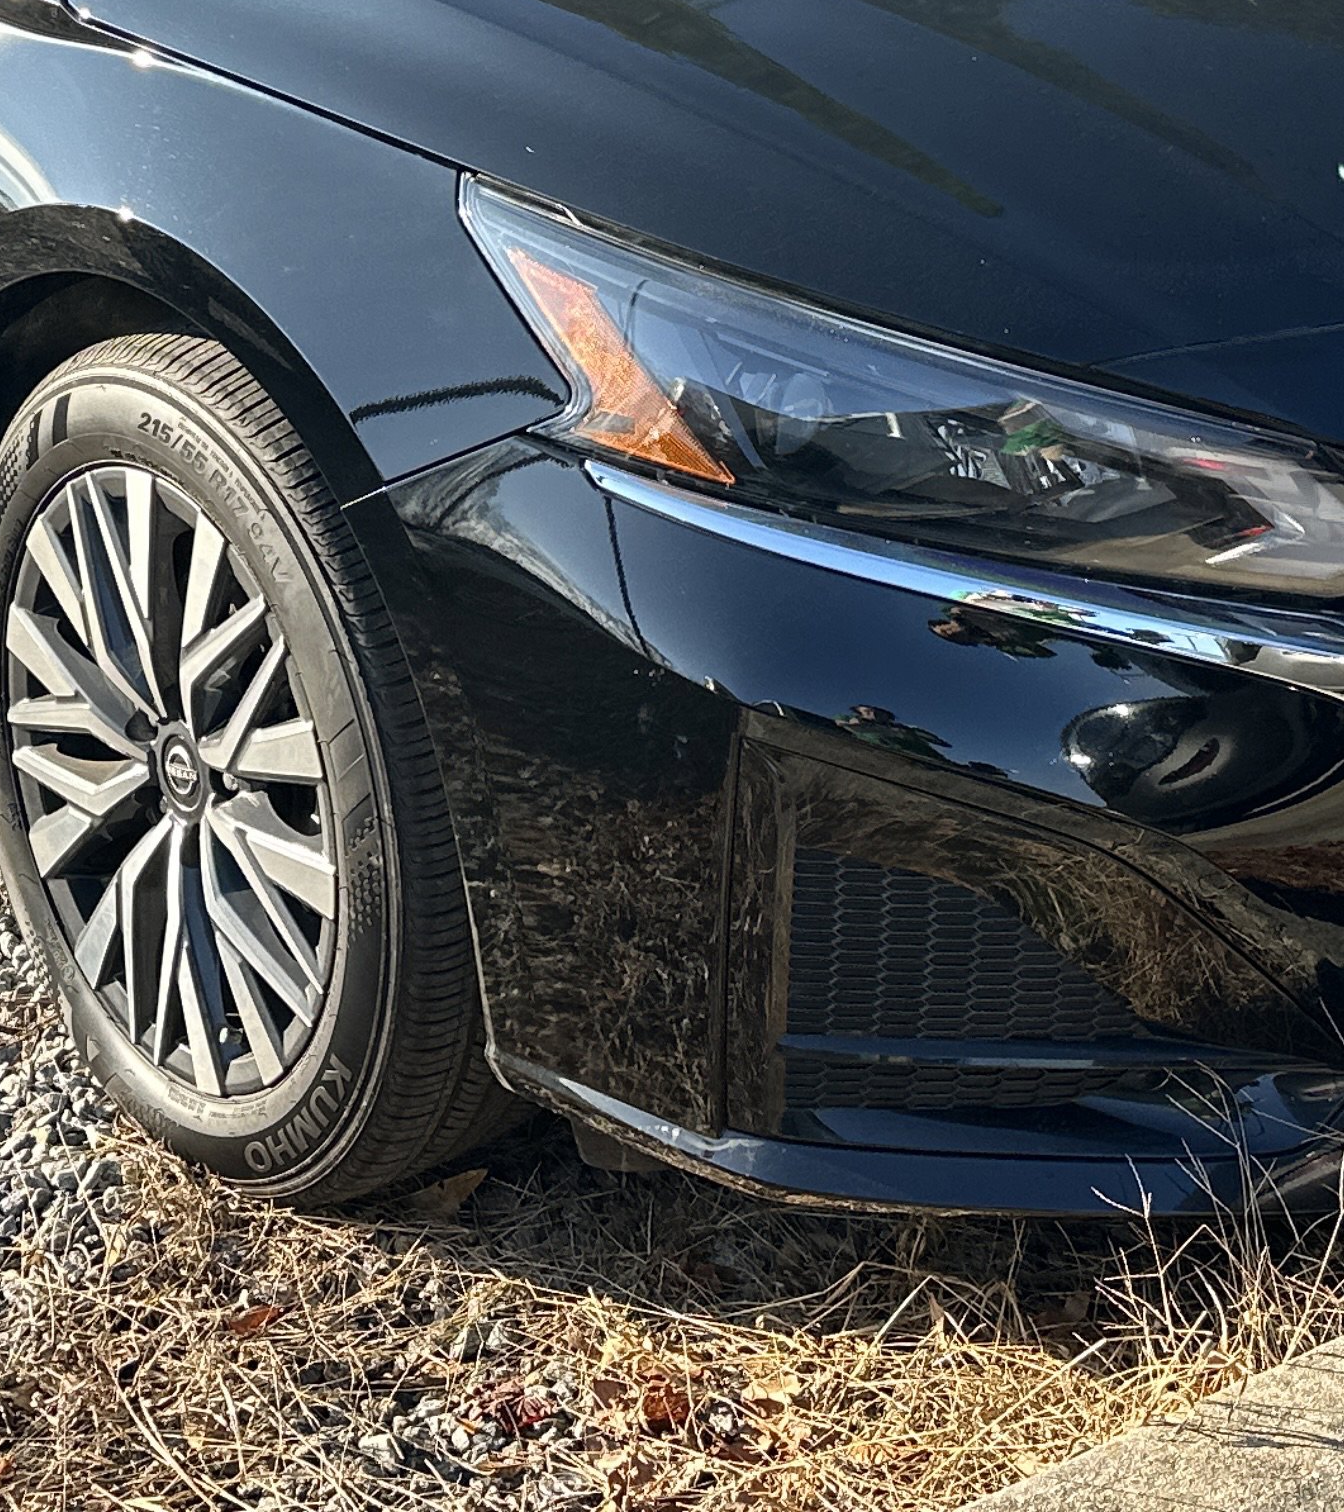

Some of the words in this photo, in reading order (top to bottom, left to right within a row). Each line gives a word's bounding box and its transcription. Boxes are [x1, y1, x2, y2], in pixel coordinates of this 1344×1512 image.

[137, 412, 209, 474] 215/55
[209, 469, 249, 518] R17
[244, 1053, 353, 1173] KUMHO
